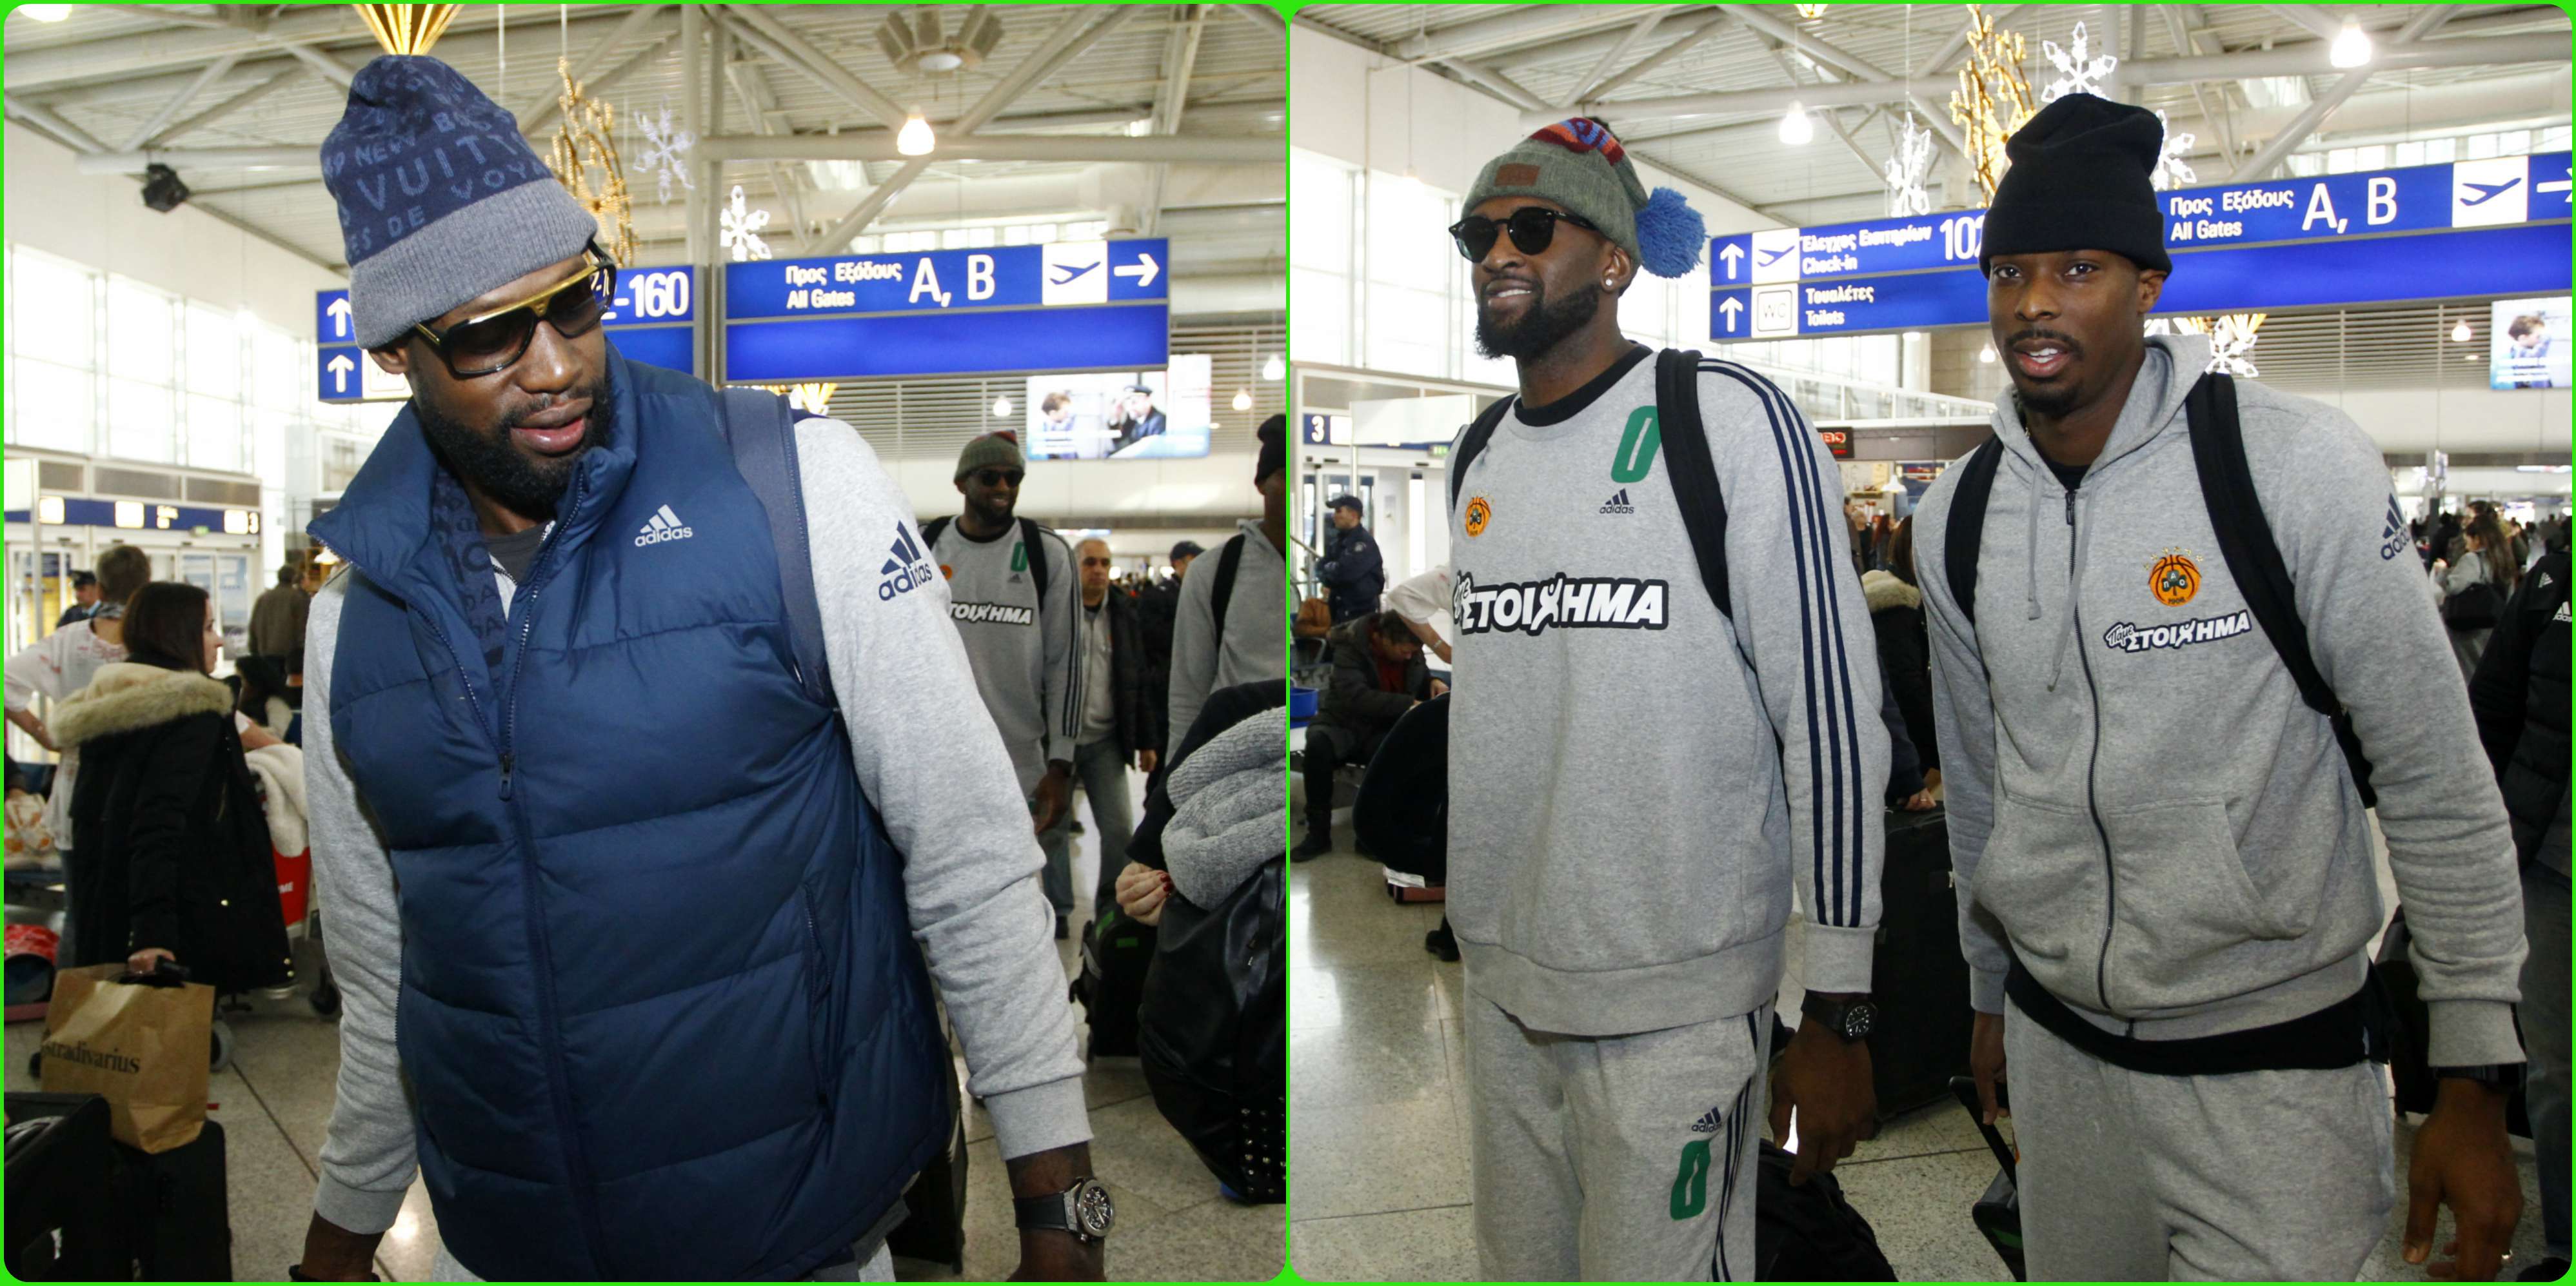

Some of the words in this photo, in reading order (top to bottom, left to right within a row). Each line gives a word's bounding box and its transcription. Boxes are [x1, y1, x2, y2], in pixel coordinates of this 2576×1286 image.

[2170, 197, 2213, 218] Προς
[2223, 189, 2294, 213] Εξόδους
[2366, 177, 2397, 226] B
[387, 205, 425, 239] DE
[2170, 223, 2193, 241] All
[2196, 220, 2243, 239] Gates
[786, 265, 827, 287] Προς
[835, 261, 902, 284] Εξόδους
[1802, 255, 1858, 275] Check-in
[967, 253, 996, 301] B
[786, 290, 808, 310] All
[811, 288, 855, 308] Gates
[1806, 284, 1874, 304] Τουαλέτες
[1806, 310, 1845, 326] Toilets
[1311, 415, 1325, 442] 3
[1600, 504, 1634, 514] adidas
[634, 524, 693, 547] adidas
[949, 602, 1032, 624] ΤΟΙΧΗΜΑ
[2126, 611, 2252, 651] ΣΤΟΙΧΗΜΑ
